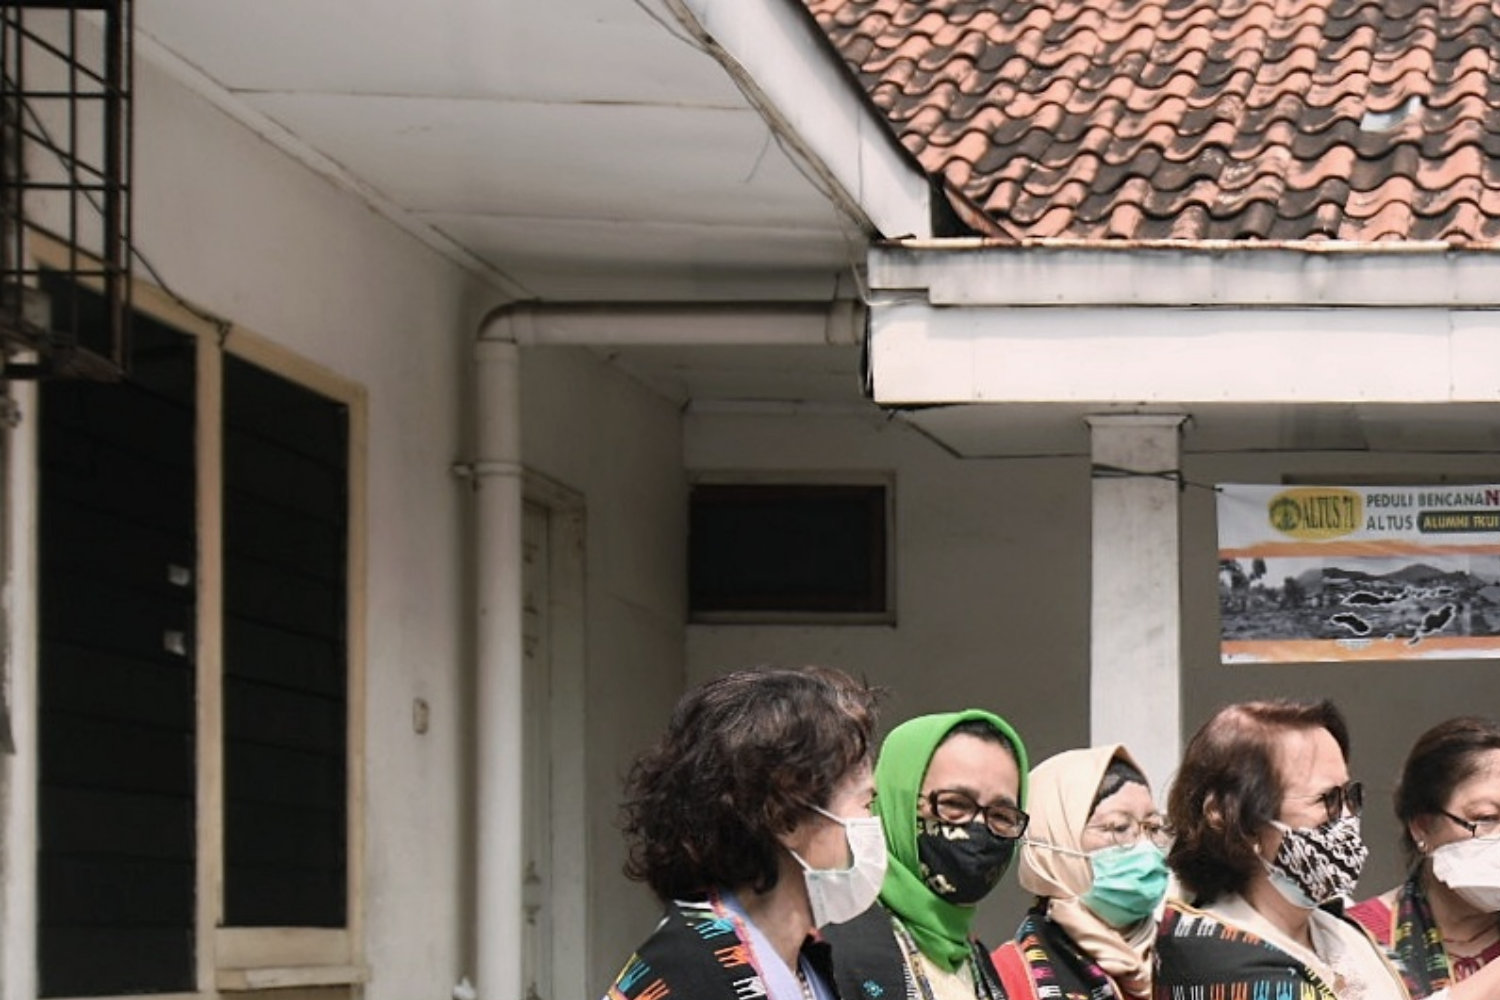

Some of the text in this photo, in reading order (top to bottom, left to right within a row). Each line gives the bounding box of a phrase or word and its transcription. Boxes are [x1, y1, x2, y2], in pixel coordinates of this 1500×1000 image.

[1366, 492, 1413, 508] PEDULI
[1418, 491, 1484, 507] BENCANA
[1302, 495, 1341, 529] ALTUS
[1366, 515, 1413, 531] ALTUS
[1423, 514, 1469, 529] ALUMNI
